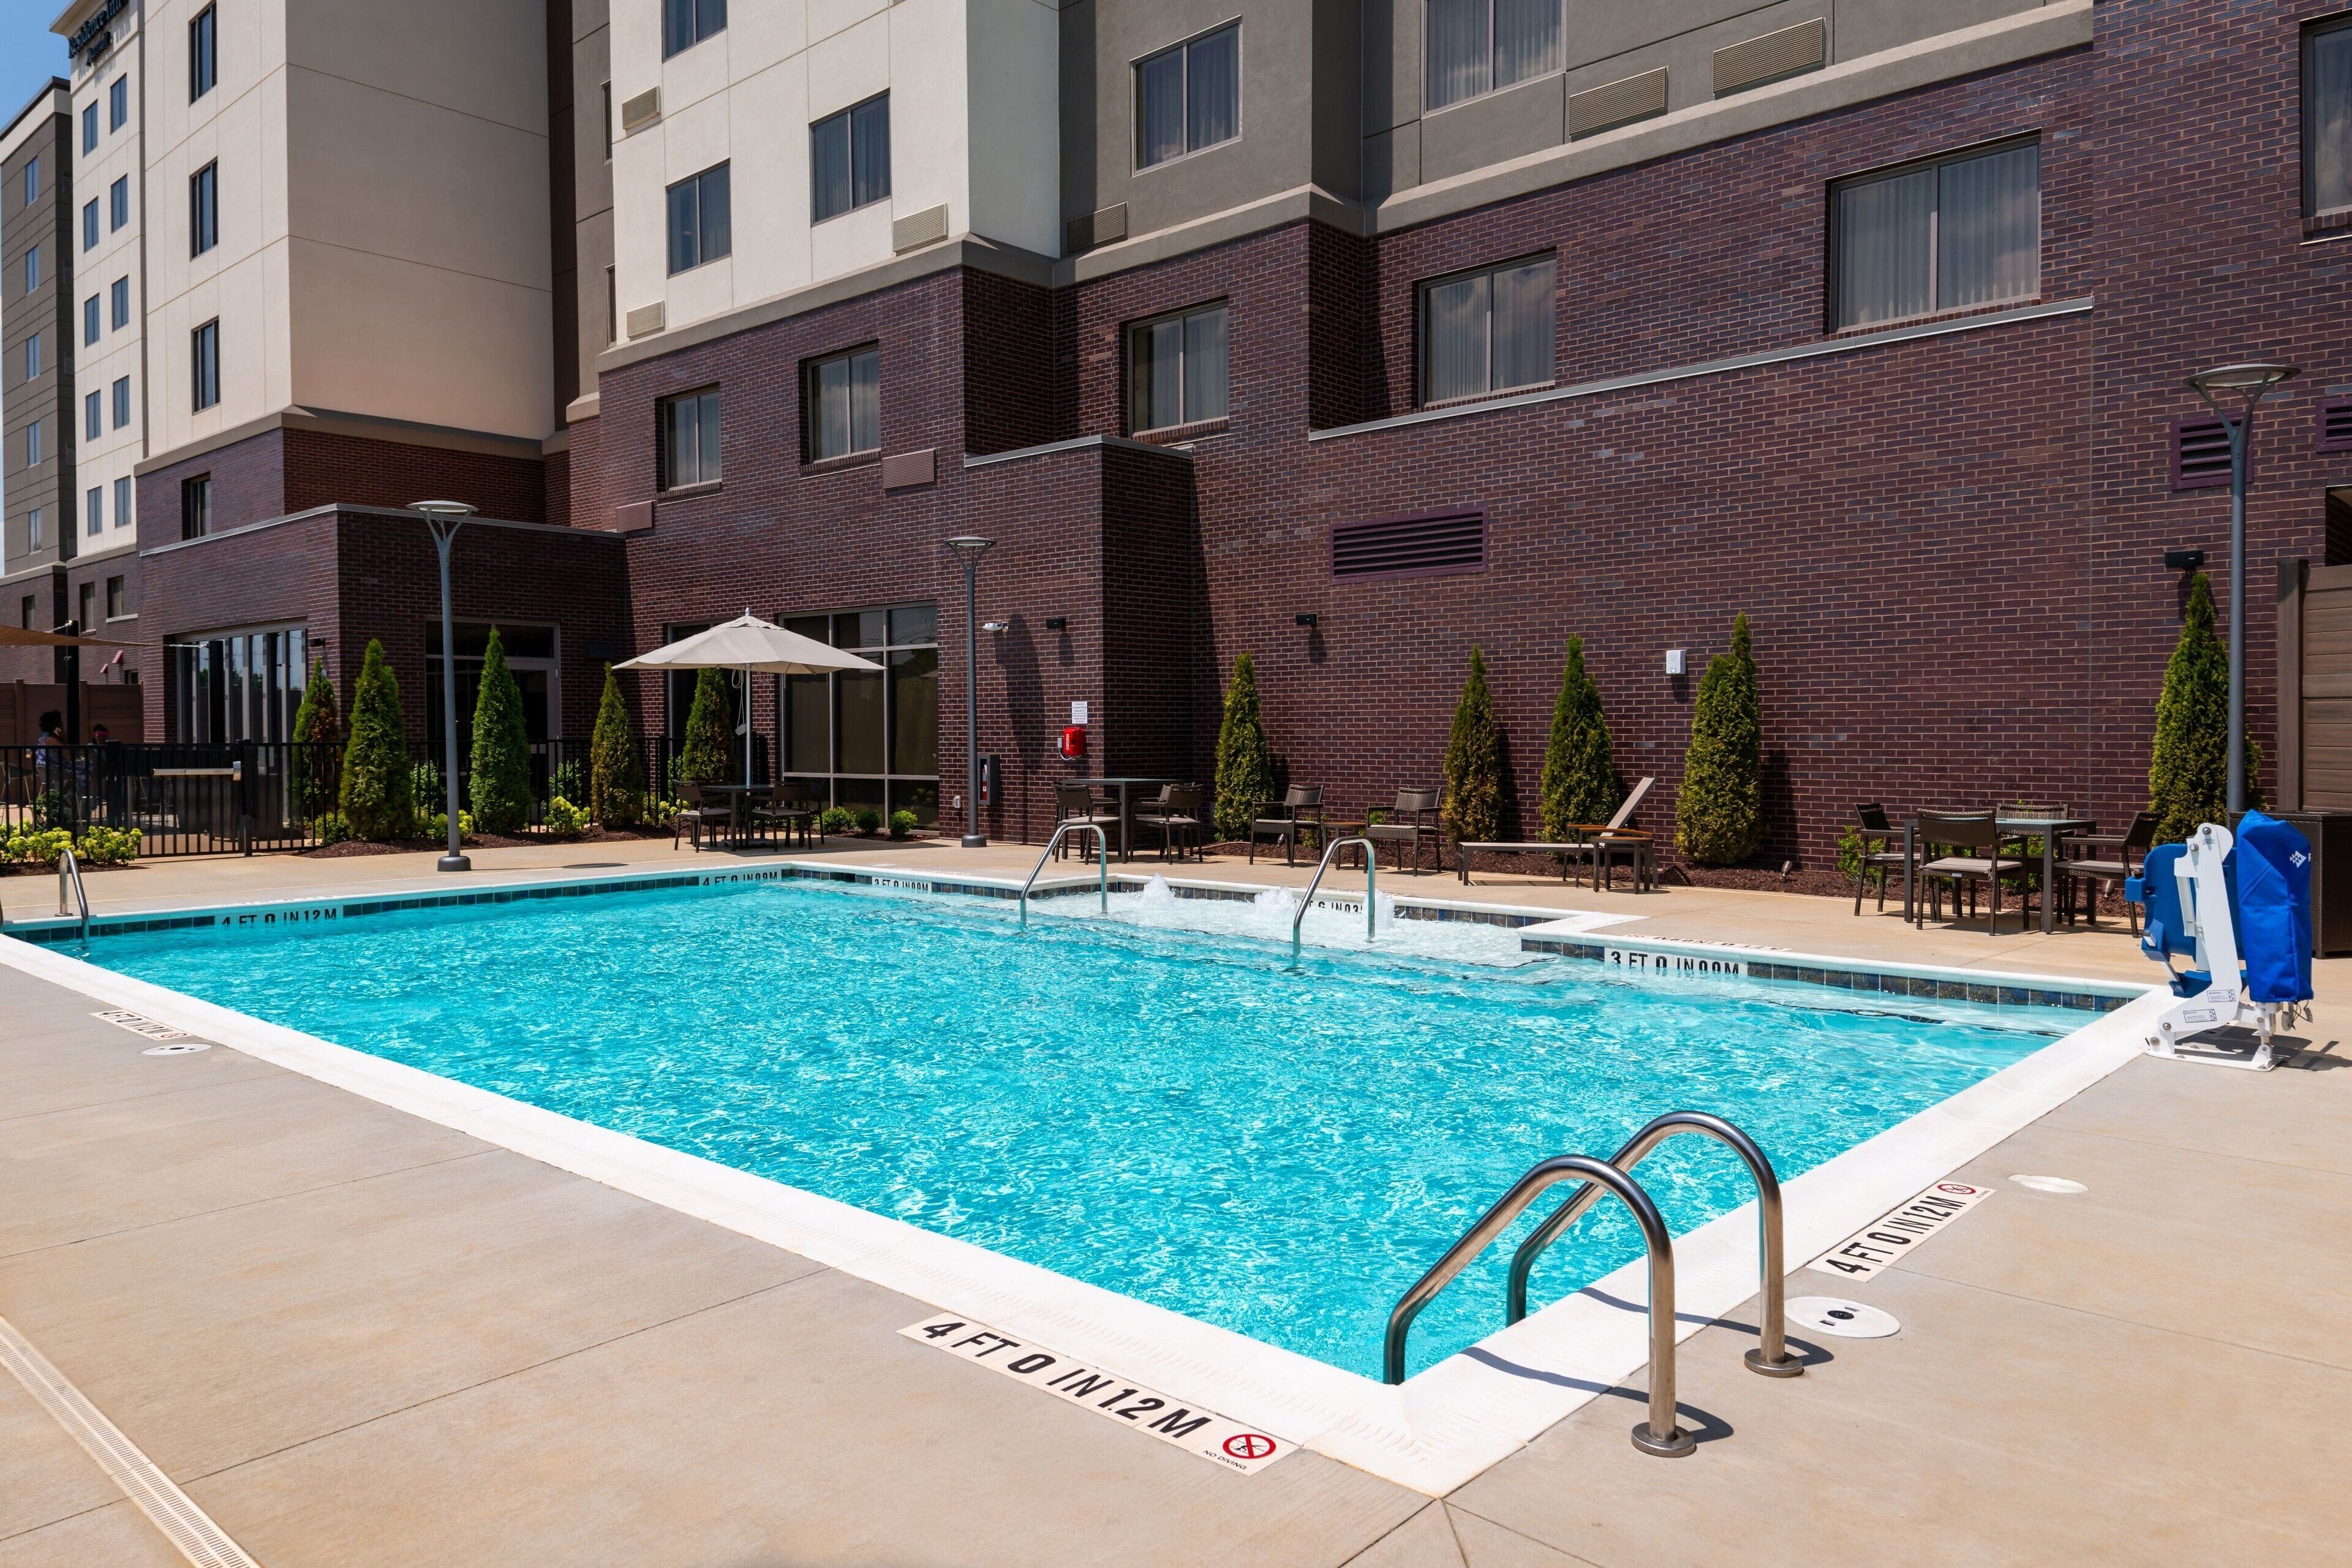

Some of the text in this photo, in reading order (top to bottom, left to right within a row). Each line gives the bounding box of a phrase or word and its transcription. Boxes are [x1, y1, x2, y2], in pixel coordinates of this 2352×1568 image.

[703, 877, 710, 886] 4
[715, 876, 726, 884] FT
[239, 914, 257, 924] FT
[284, 911, 299, 921] IN
[1610, 951, 1621, 964] 3
[1629, 952, 1648, 967] FT
[1677, 957, 1694, 970] IN
[1882, 1217, 1935, 1234] IN
[1839, 1242, 1894, 1262] FT
[1825, 1259, 1871, 1273] 4
[922, 1322, 967, 1339] 4
[950, 1332, 1021, 1357] FT
[1046, 1368, 1115, 1397] IN
[1218, 1456, 1247, 1470] DIVING
